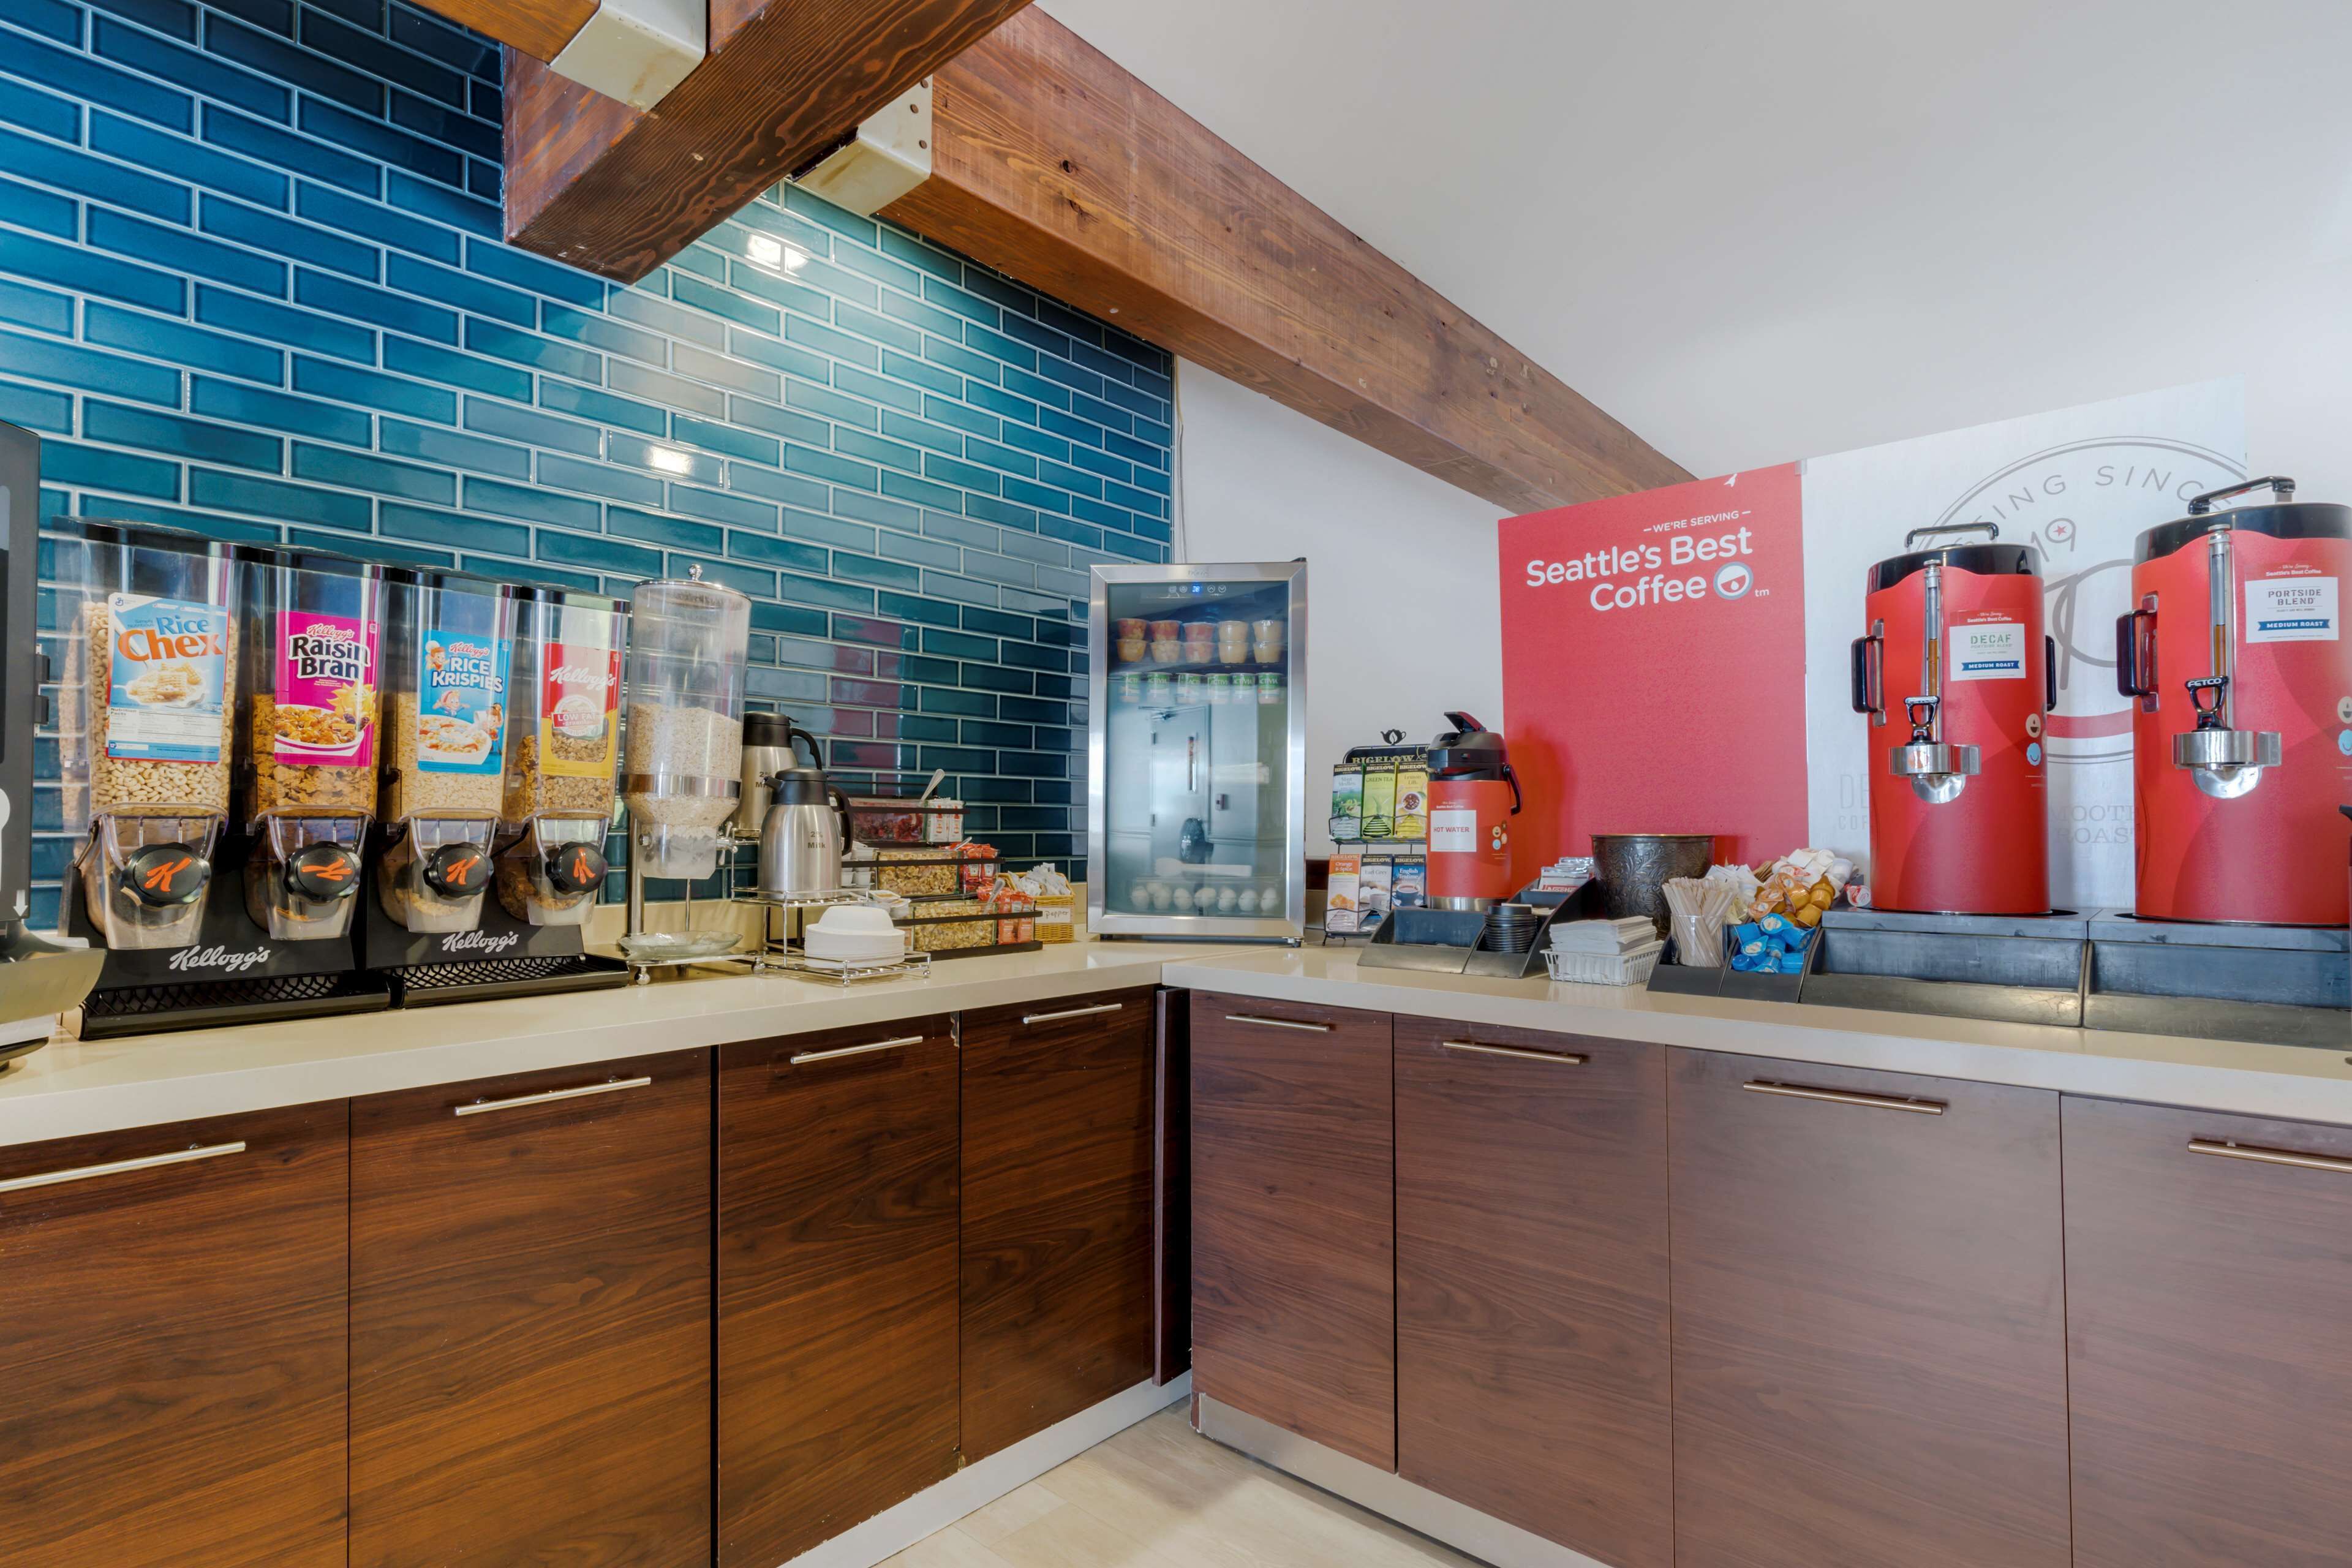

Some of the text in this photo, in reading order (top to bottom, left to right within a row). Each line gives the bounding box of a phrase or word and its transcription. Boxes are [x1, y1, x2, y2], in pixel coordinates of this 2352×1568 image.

[1653, 511, 1740, 533] WE'RE SERVING
[1526, 527, 1754, 588] Seattle's Best
[1590, 574, 1707, 611] Coffee
[1754, 587, 1770, 597] tm
[2268, 589, 2321, 598] PORTSIDE
[156, 614, 210, 635] Rice
[307, 624, 354, 641] Kellogg's
[117, 628, 224, 662] Chex
[450, 642, 489, 657] Kellogg's
[1970, 634, 2011, 644] DECAF
[292, 636, 369, 665] Raisin
[301, 657, 359, 679] Bran
[451, 657, 491, 676] RICE
[432, 671, 503, 693] KRISPIES
[550, 665, 617, 691] Kellogg's
[2187, 677, 2222, 687] FETCO
[1351, 755, 1415, 764] BIGELOW
[442, 930, 519, 953] Kellogg's
[169, 945, 271, 972] Kellogg's
